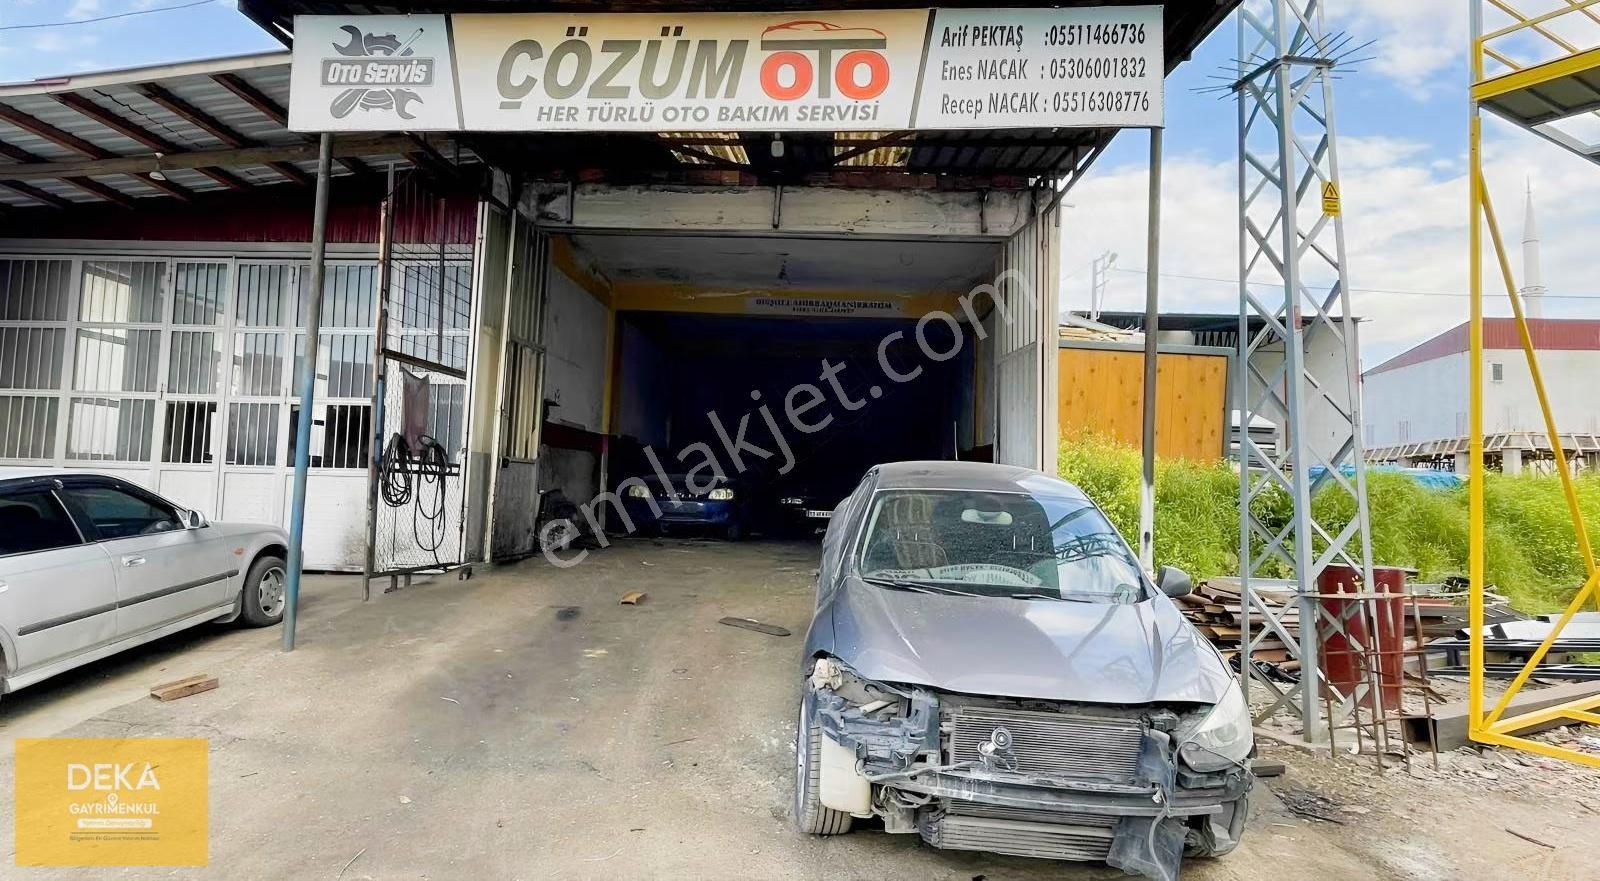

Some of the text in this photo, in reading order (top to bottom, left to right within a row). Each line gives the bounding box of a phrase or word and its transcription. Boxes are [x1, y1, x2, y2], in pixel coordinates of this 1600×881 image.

[941, 23, 1146, 52] Arif PEKTAŞ :05511466736
[328, 63, 362, 83] OTO
[497, 26, 889, 109] ÇÖZÜM OTO
[941, 59, 972, 81] Enes
[977, 59, 1028, 80] NACAK
[1049, 57, 1146, 79] 05306001832
[536, 100, 879, 122] HER TÜRLÜ OTO BAKIM SERVİSİ
[941, 92, 983, 119] Recep
[988, 92, 1039, 113] NACAK
[1052, 91, 1150, 113] 05516308776
